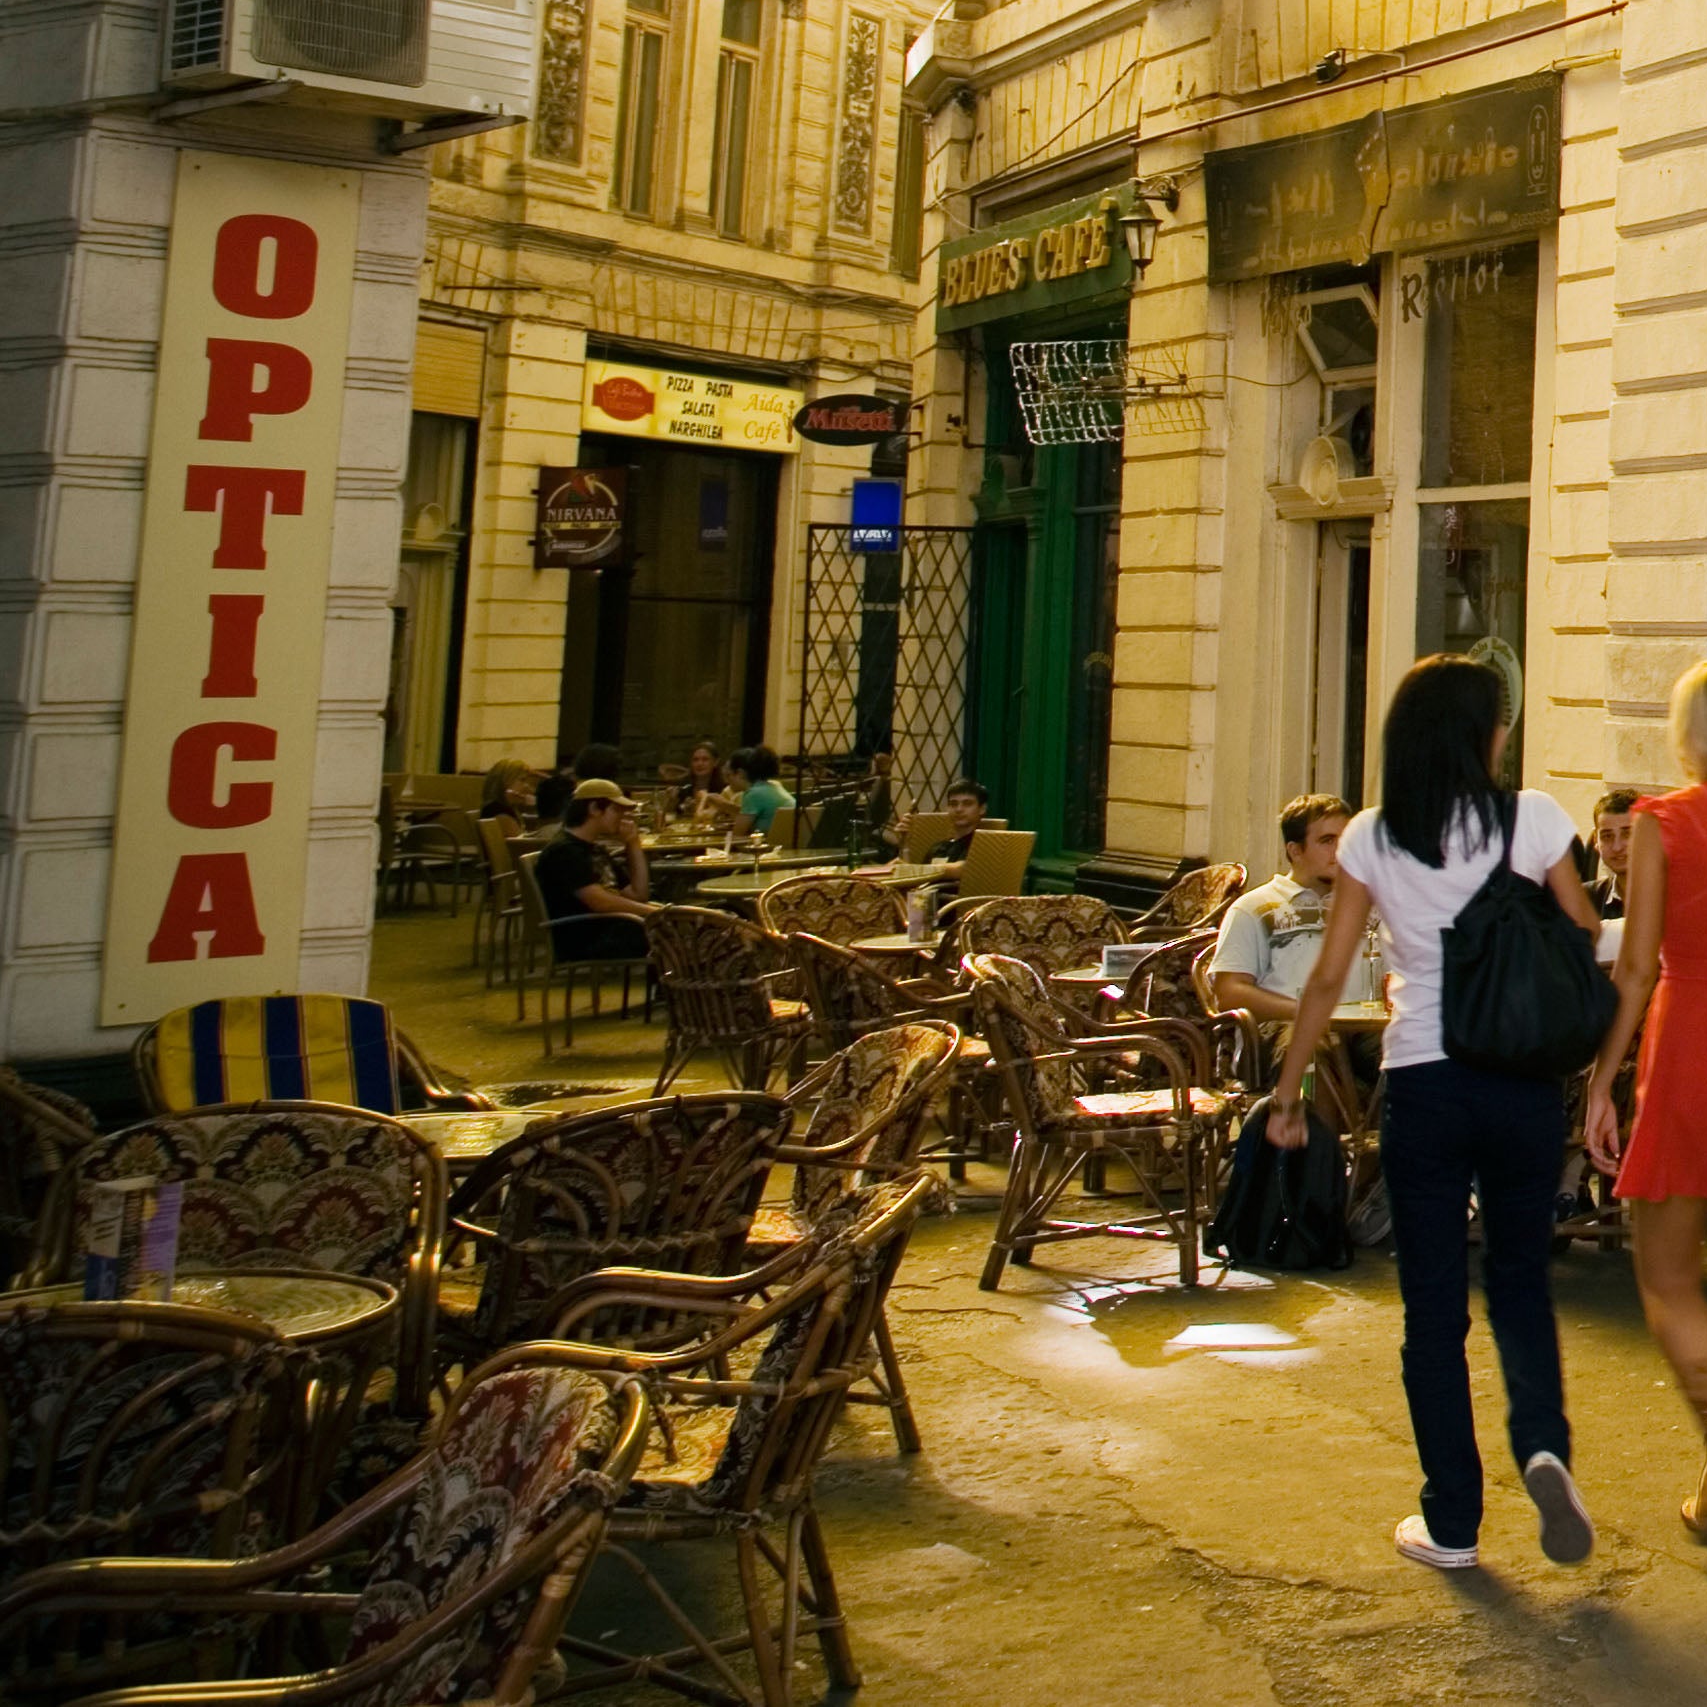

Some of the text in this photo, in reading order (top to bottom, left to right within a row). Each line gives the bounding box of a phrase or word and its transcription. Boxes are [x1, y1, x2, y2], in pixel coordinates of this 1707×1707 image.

[942, 238, 1030, 308] BLUES
[666, 375, 734, 398] PIZZA PASTA
[681, 400, 715, 417] SALATA
[743, 393, 784, 414] Aida
[669, 420, 723, 441] NARGHILEA
[743, 420, 781, 443] Café
[547, 507, 617, 522] NIRVANA
[147, 213, 318, 964] OPTICA
